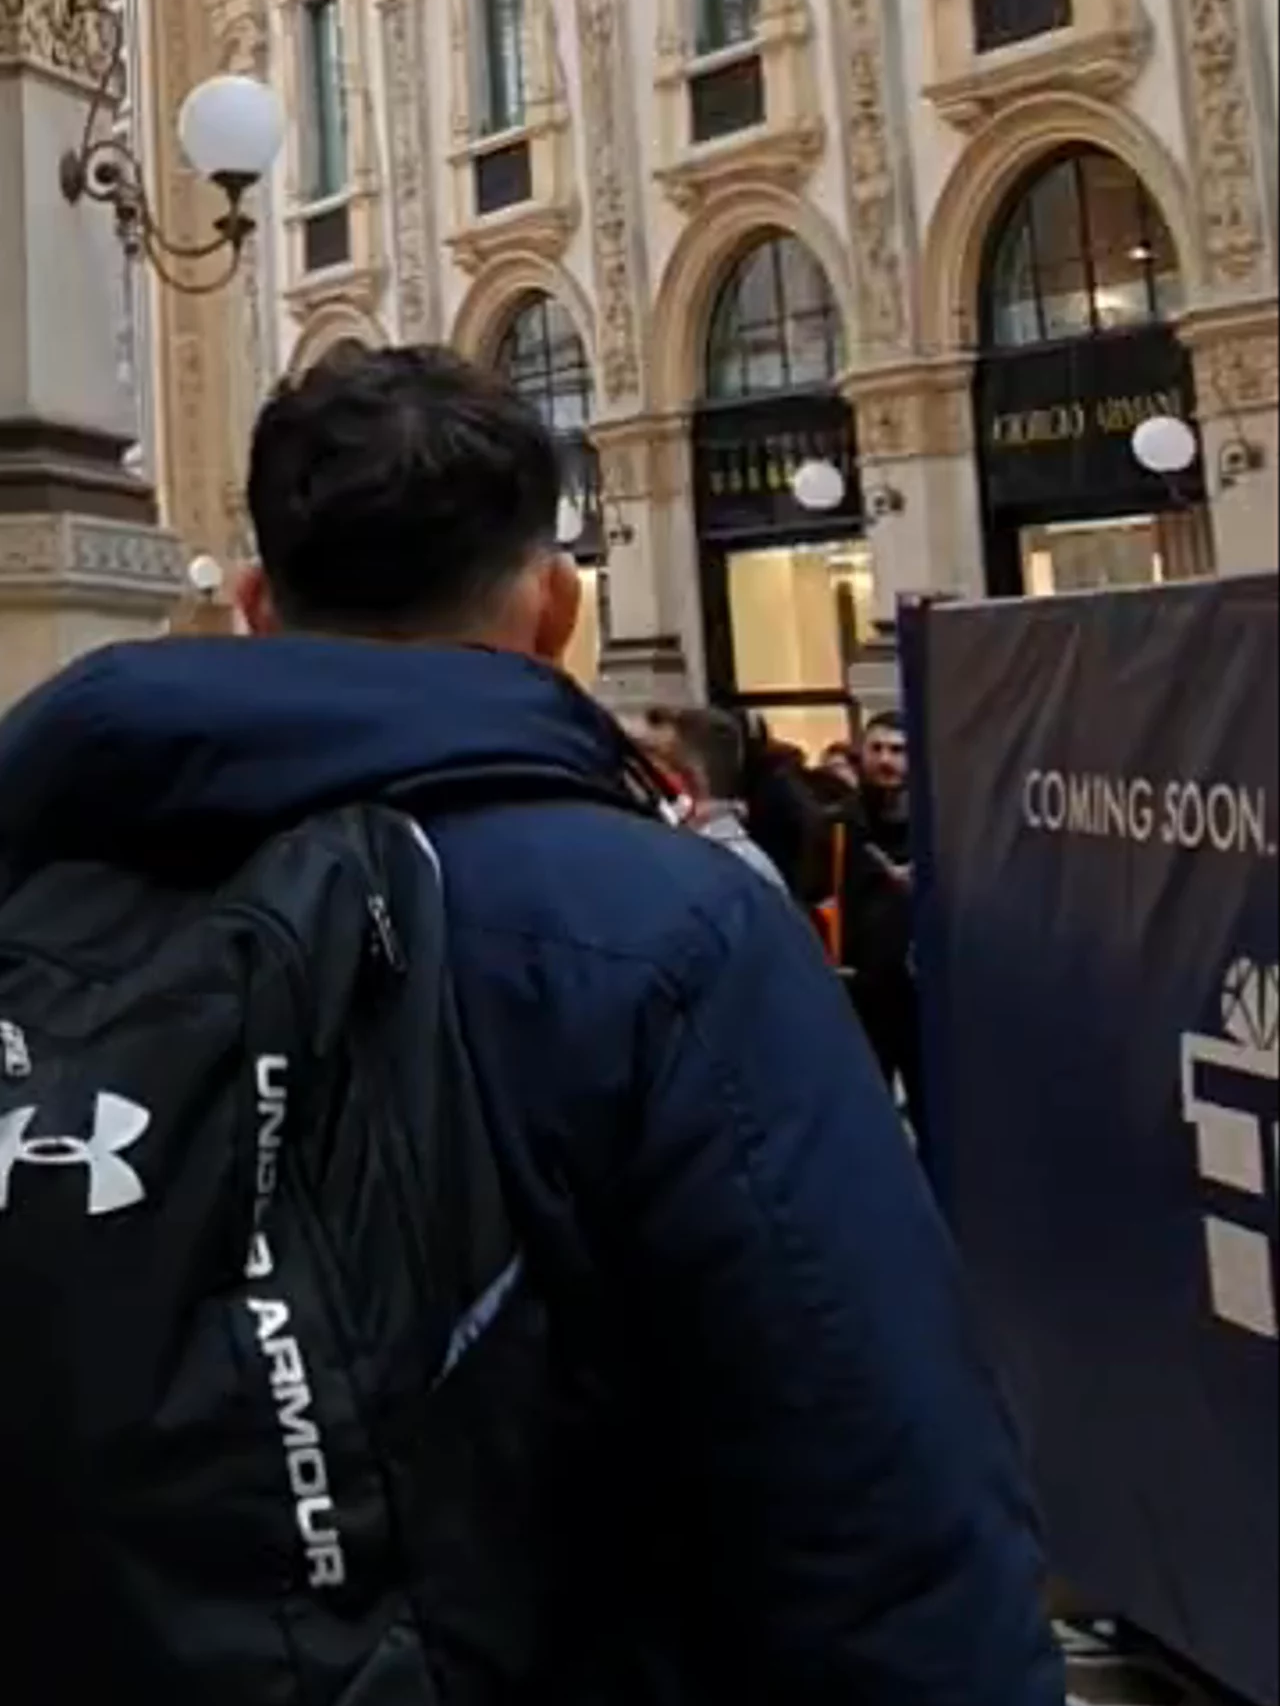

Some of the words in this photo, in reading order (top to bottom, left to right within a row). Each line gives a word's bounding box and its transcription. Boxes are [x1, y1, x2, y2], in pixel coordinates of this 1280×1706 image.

[1024, 767, 1153, 843] COMING
[1162, 780, 1277, 855] SOON.
[246, 1298, 345, 1587] ARMOUR
